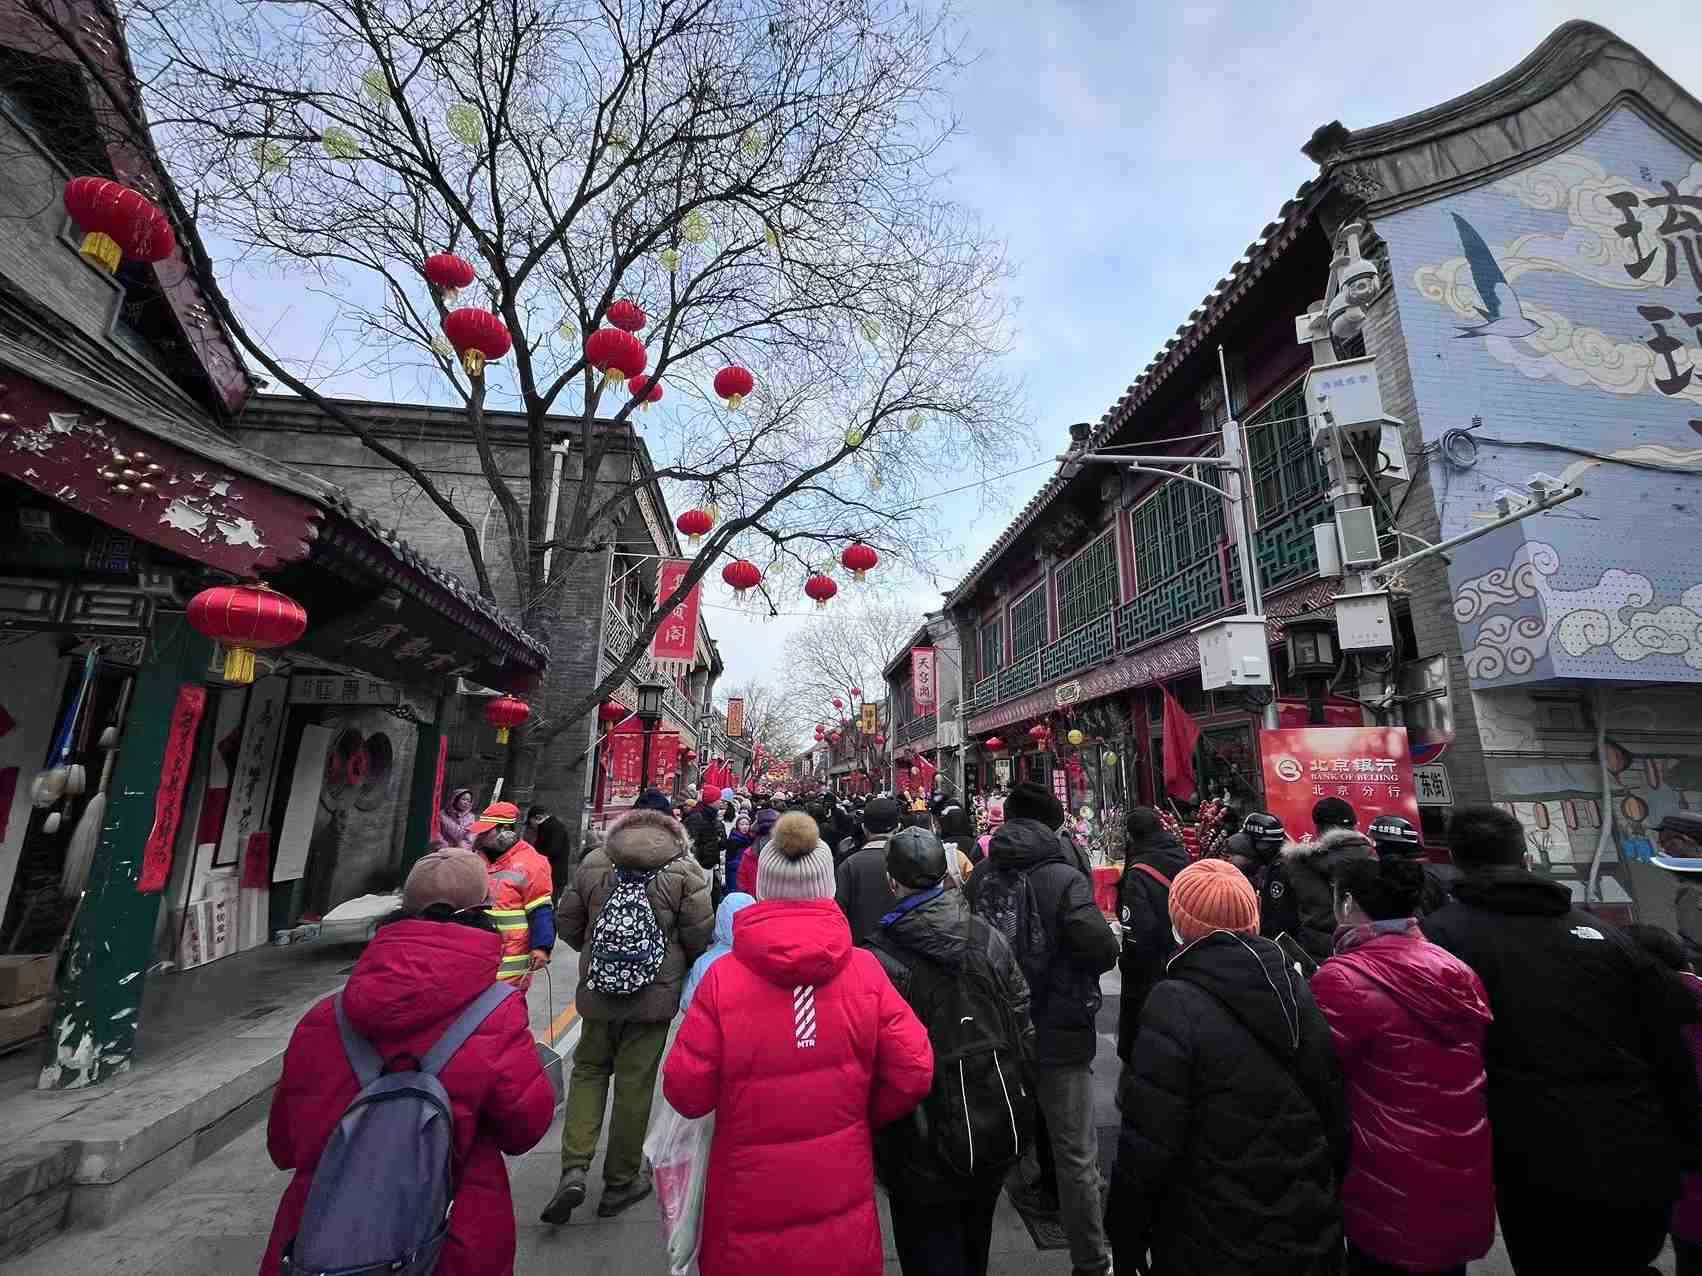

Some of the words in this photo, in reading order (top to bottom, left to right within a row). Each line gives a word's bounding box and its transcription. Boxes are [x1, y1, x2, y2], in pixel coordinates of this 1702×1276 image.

[1310, 758, 1397, 773] 北京银行
[1311, 773, 1339, 781] BANK
[1341, 773, 1353, 781] OF
[1356, 773, 1399, 781] BEIJING
[1312, 784, 1400, 797] 北京分行
